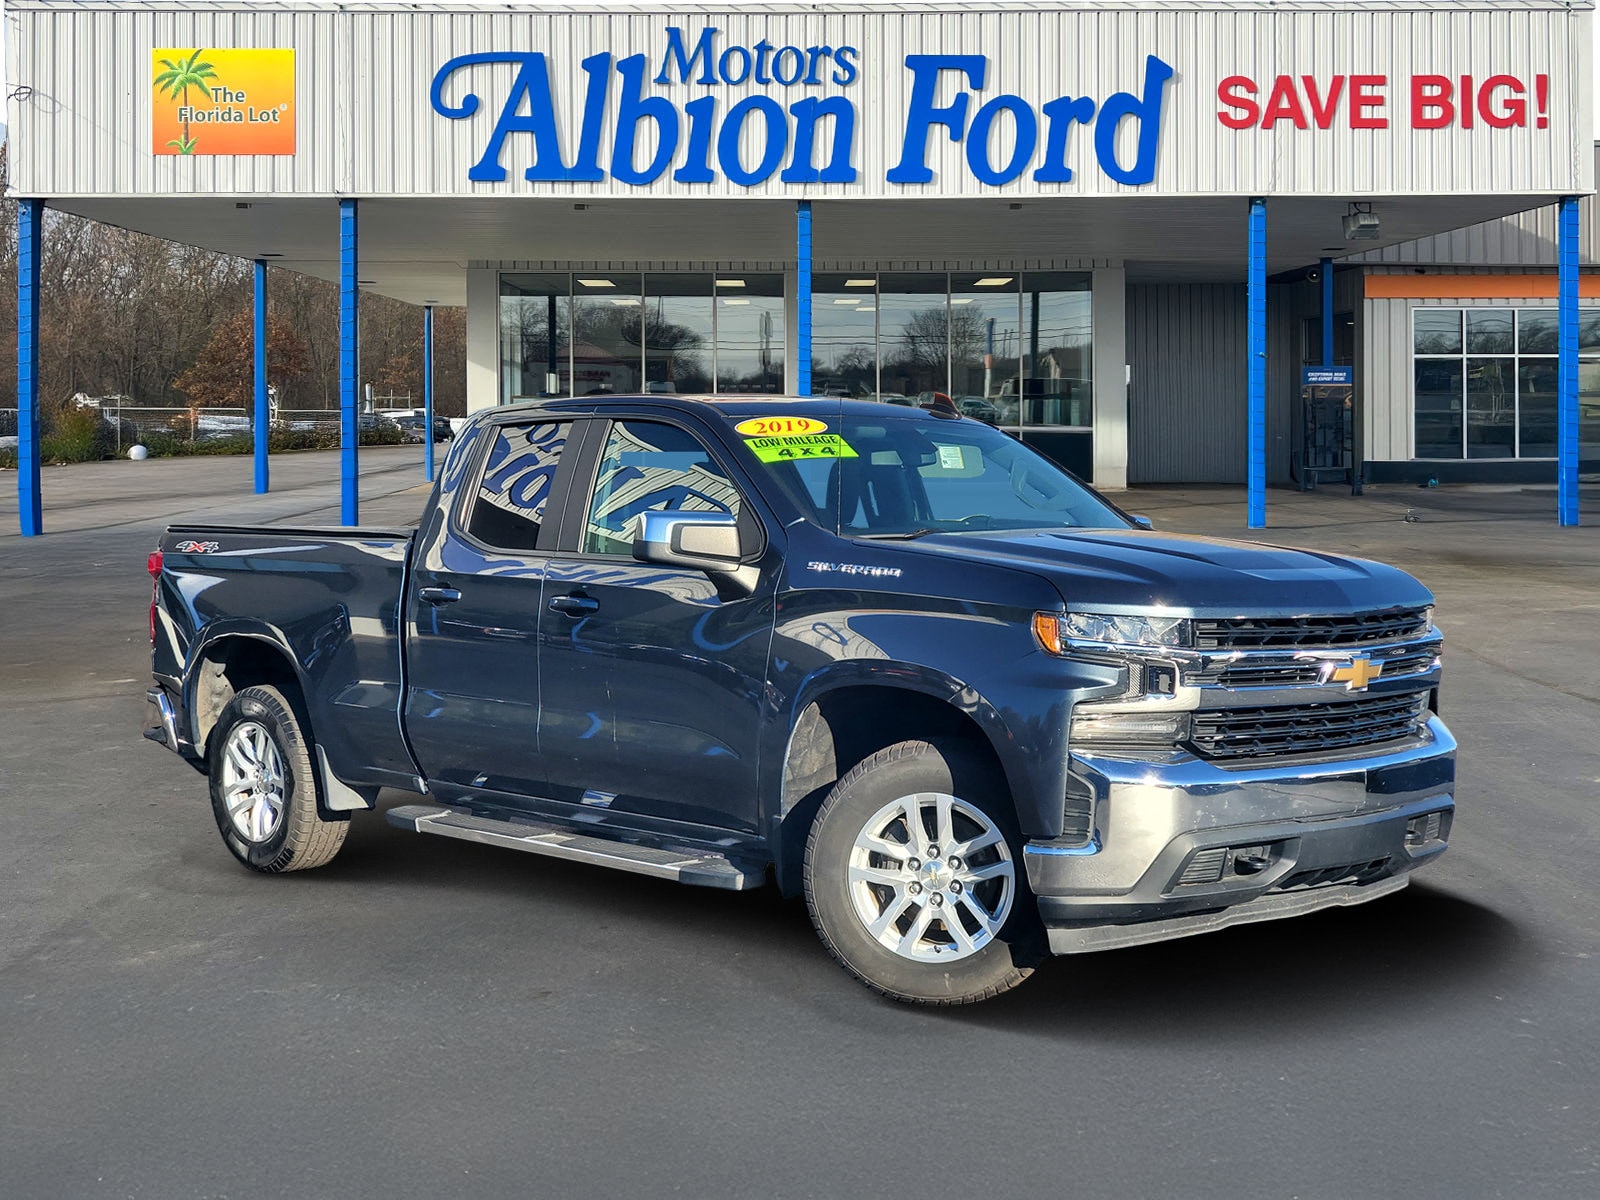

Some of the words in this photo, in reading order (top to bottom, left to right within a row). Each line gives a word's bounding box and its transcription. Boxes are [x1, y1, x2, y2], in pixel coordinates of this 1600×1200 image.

[653, 27, 857, 85] Motors
[211, 87, 245, 103] The
[1217, 75, 1388, 129] SAVE
[1411, 74, 1548, 129] BIG!
[178, 107, 243, 122] Florida
[249, 107, 279, 122] Lot
[430, 52, 857, 186] Albion
[886, 54, 1174, 186] Ford
[754, 419, 810, 434] 2019
[752, 438, 780, 448] LOW
[784, 435, 837, 445] MILEAGE
[806, 561, 902, 577] SILVERADO
